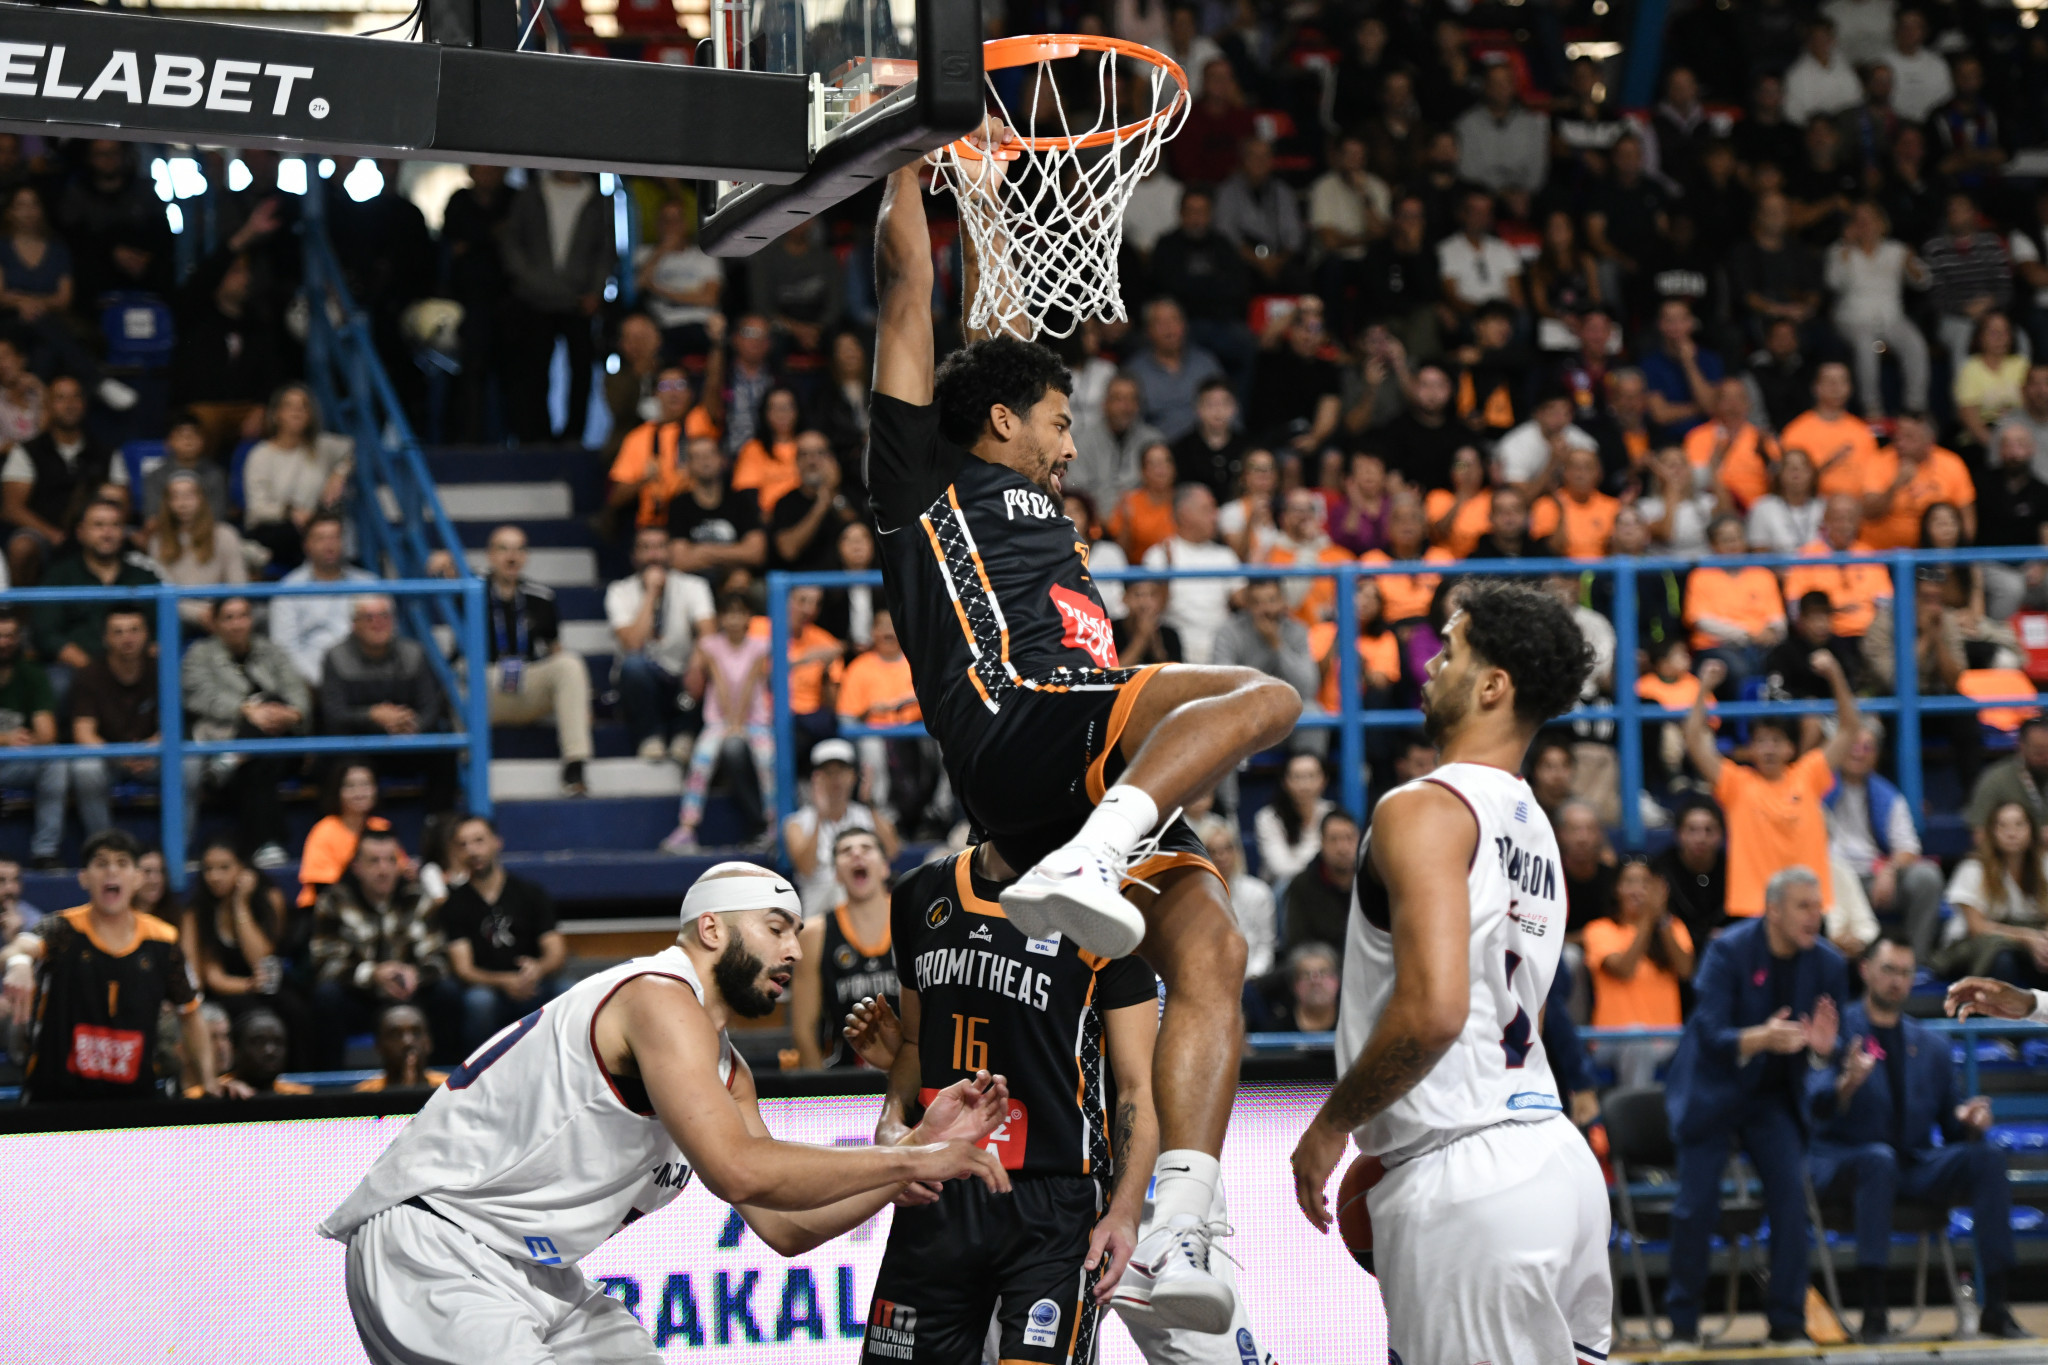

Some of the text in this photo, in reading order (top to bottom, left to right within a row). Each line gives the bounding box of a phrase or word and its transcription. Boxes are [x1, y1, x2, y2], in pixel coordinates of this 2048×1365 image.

[1034, 943, 1050, 952] GBL
[914, 947, 1052, 1012] PROMITHEAS
[951, 1013, 990, 1073] 16
